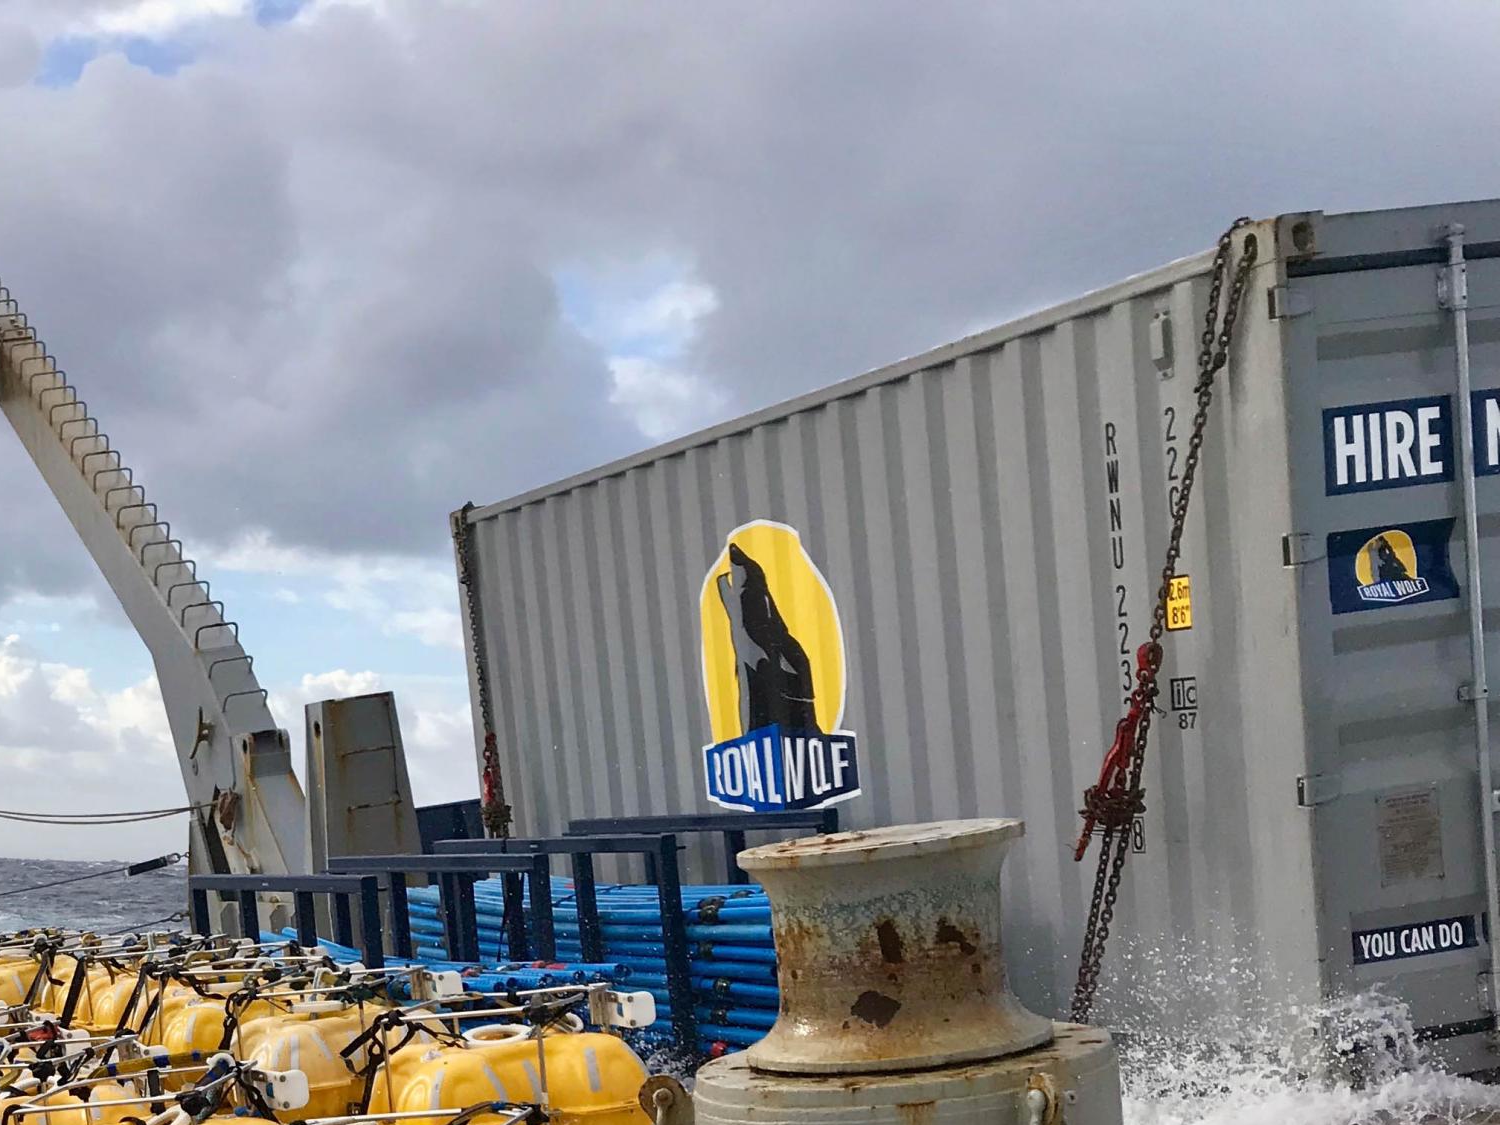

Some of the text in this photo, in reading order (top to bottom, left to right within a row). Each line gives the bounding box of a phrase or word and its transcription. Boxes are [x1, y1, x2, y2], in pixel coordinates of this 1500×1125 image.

[1334, 406, 1443, 485] HIRE
[1105, 422, 1124, 568] RWNU
[1363, 580, 1422, 598] ROYAL WOLF
[1179, 712, 1197, 729] 87
[713, 737, 782, 804] ROYAL
[1360, 921, 1463, 959] YOU CAN DO
